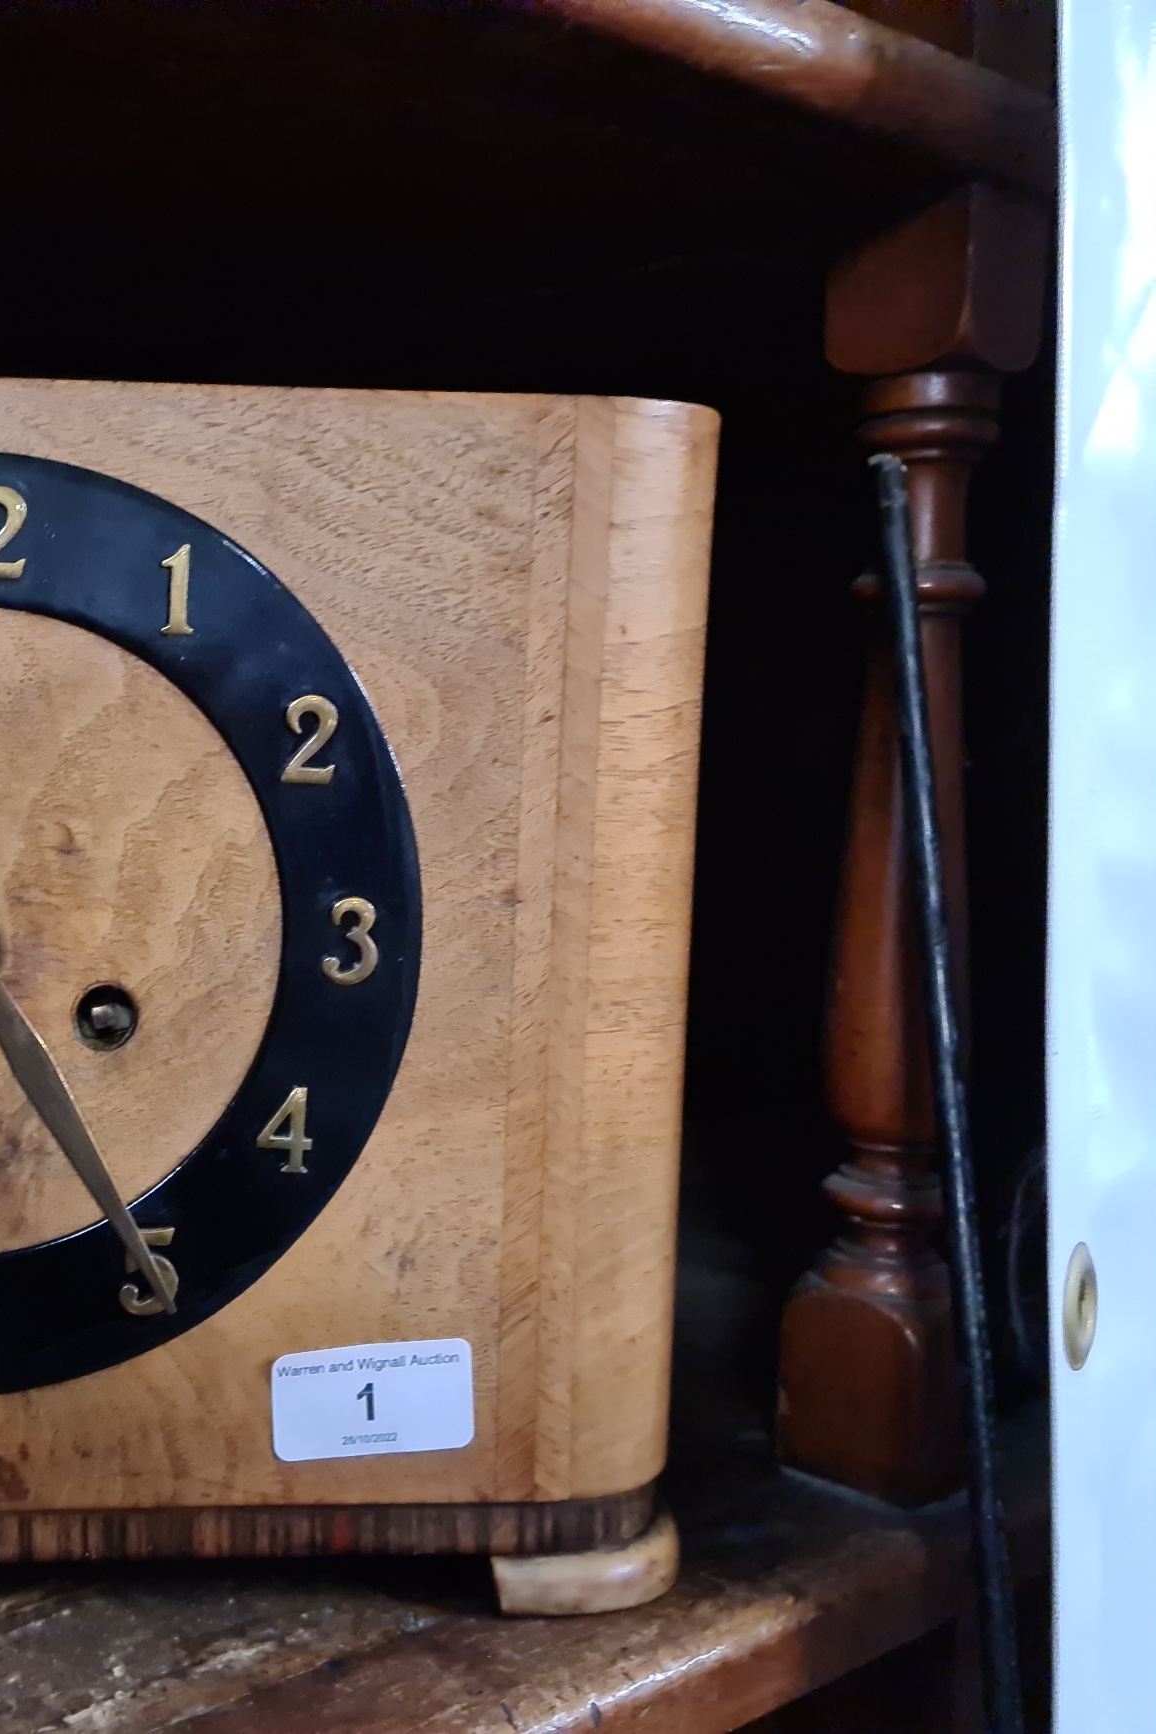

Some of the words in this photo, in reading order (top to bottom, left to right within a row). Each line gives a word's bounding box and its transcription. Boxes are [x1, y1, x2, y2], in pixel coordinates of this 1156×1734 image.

[161, 544, 194, 635] 1
[280, 694, 339, 784] 2
[321, 896, 379, 985] 3
[256, 1087, 313, 1173] 4
[119, 1226, 179, 1317] 5
[277, 1364, 325, 1378] Warren
[328, 1360, 354, 1372] and
[357, 1355, 406, 1371] Wignall
[410, 1353, 459, 1365] Auction
[357, 1383, 374, 1420] 1
